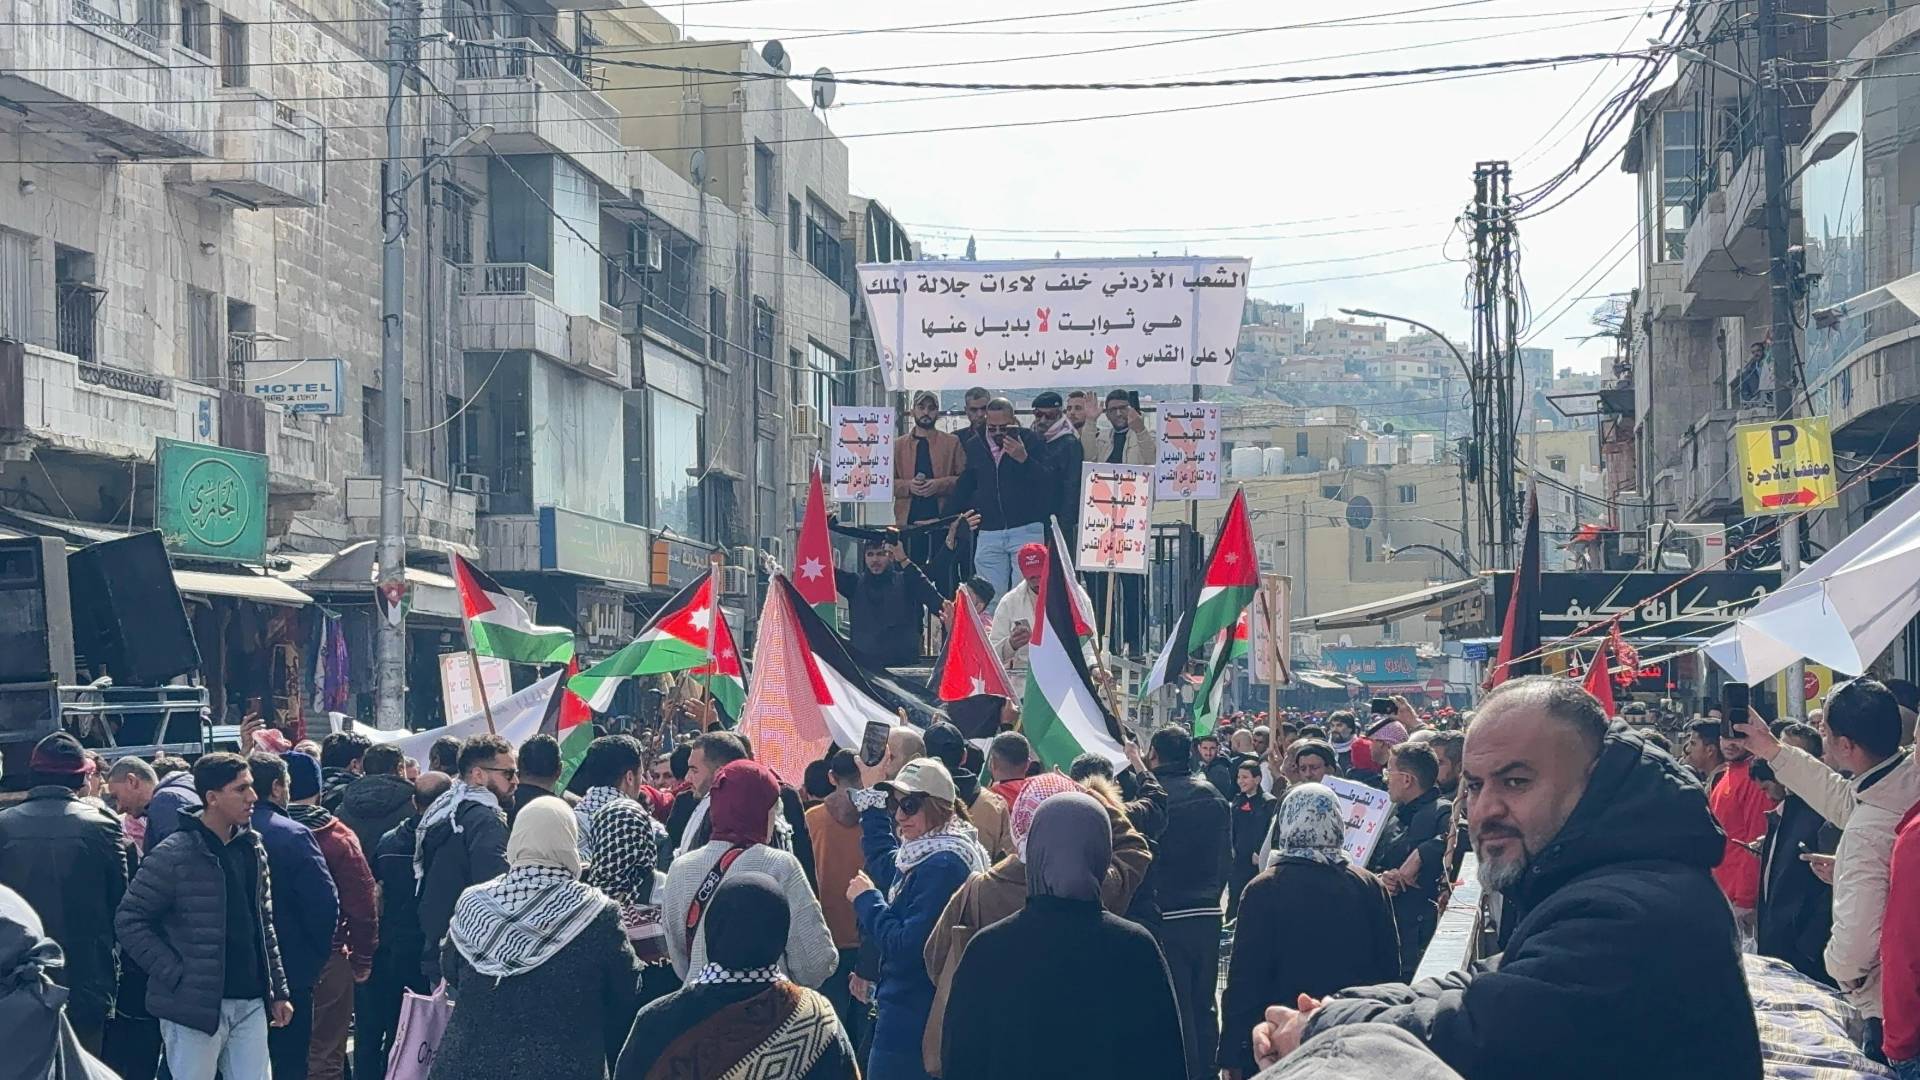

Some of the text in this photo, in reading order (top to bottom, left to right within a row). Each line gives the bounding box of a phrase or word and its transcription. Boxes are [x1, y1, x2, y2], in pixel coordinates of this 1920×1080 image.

[865, 266, 1246, 298] الشعب الأردني خلف لاءات جلالة الملك
[921, 306, 1182, 338] هي ثوابت لا بديل عنها
[964, 347, 978, 374] لا
[1051, 347, 1094, 371] للوطن
[1104, 343, 1120, 370] لا
[1190, 346, 1218, 368] على
[1223, 347, 1236, 366] لا
[254, 383, 333, 394] HOTEL
[839, 412, 879, 427] للتوطين
[1164, 407, 1205, 422] للتوطين
[1771, 424, 1798, 459] P
[1090, 468, 1137, 484] للتوطين
[1746, 460, 1830, 486] موقف بالاجرة
[1540, 586, 1635, 628] كيف
[1376, 798, 1387, 810] لا
[1366, 821, 1376, 833] لا
[1355, 846, 1366, 858] لا
